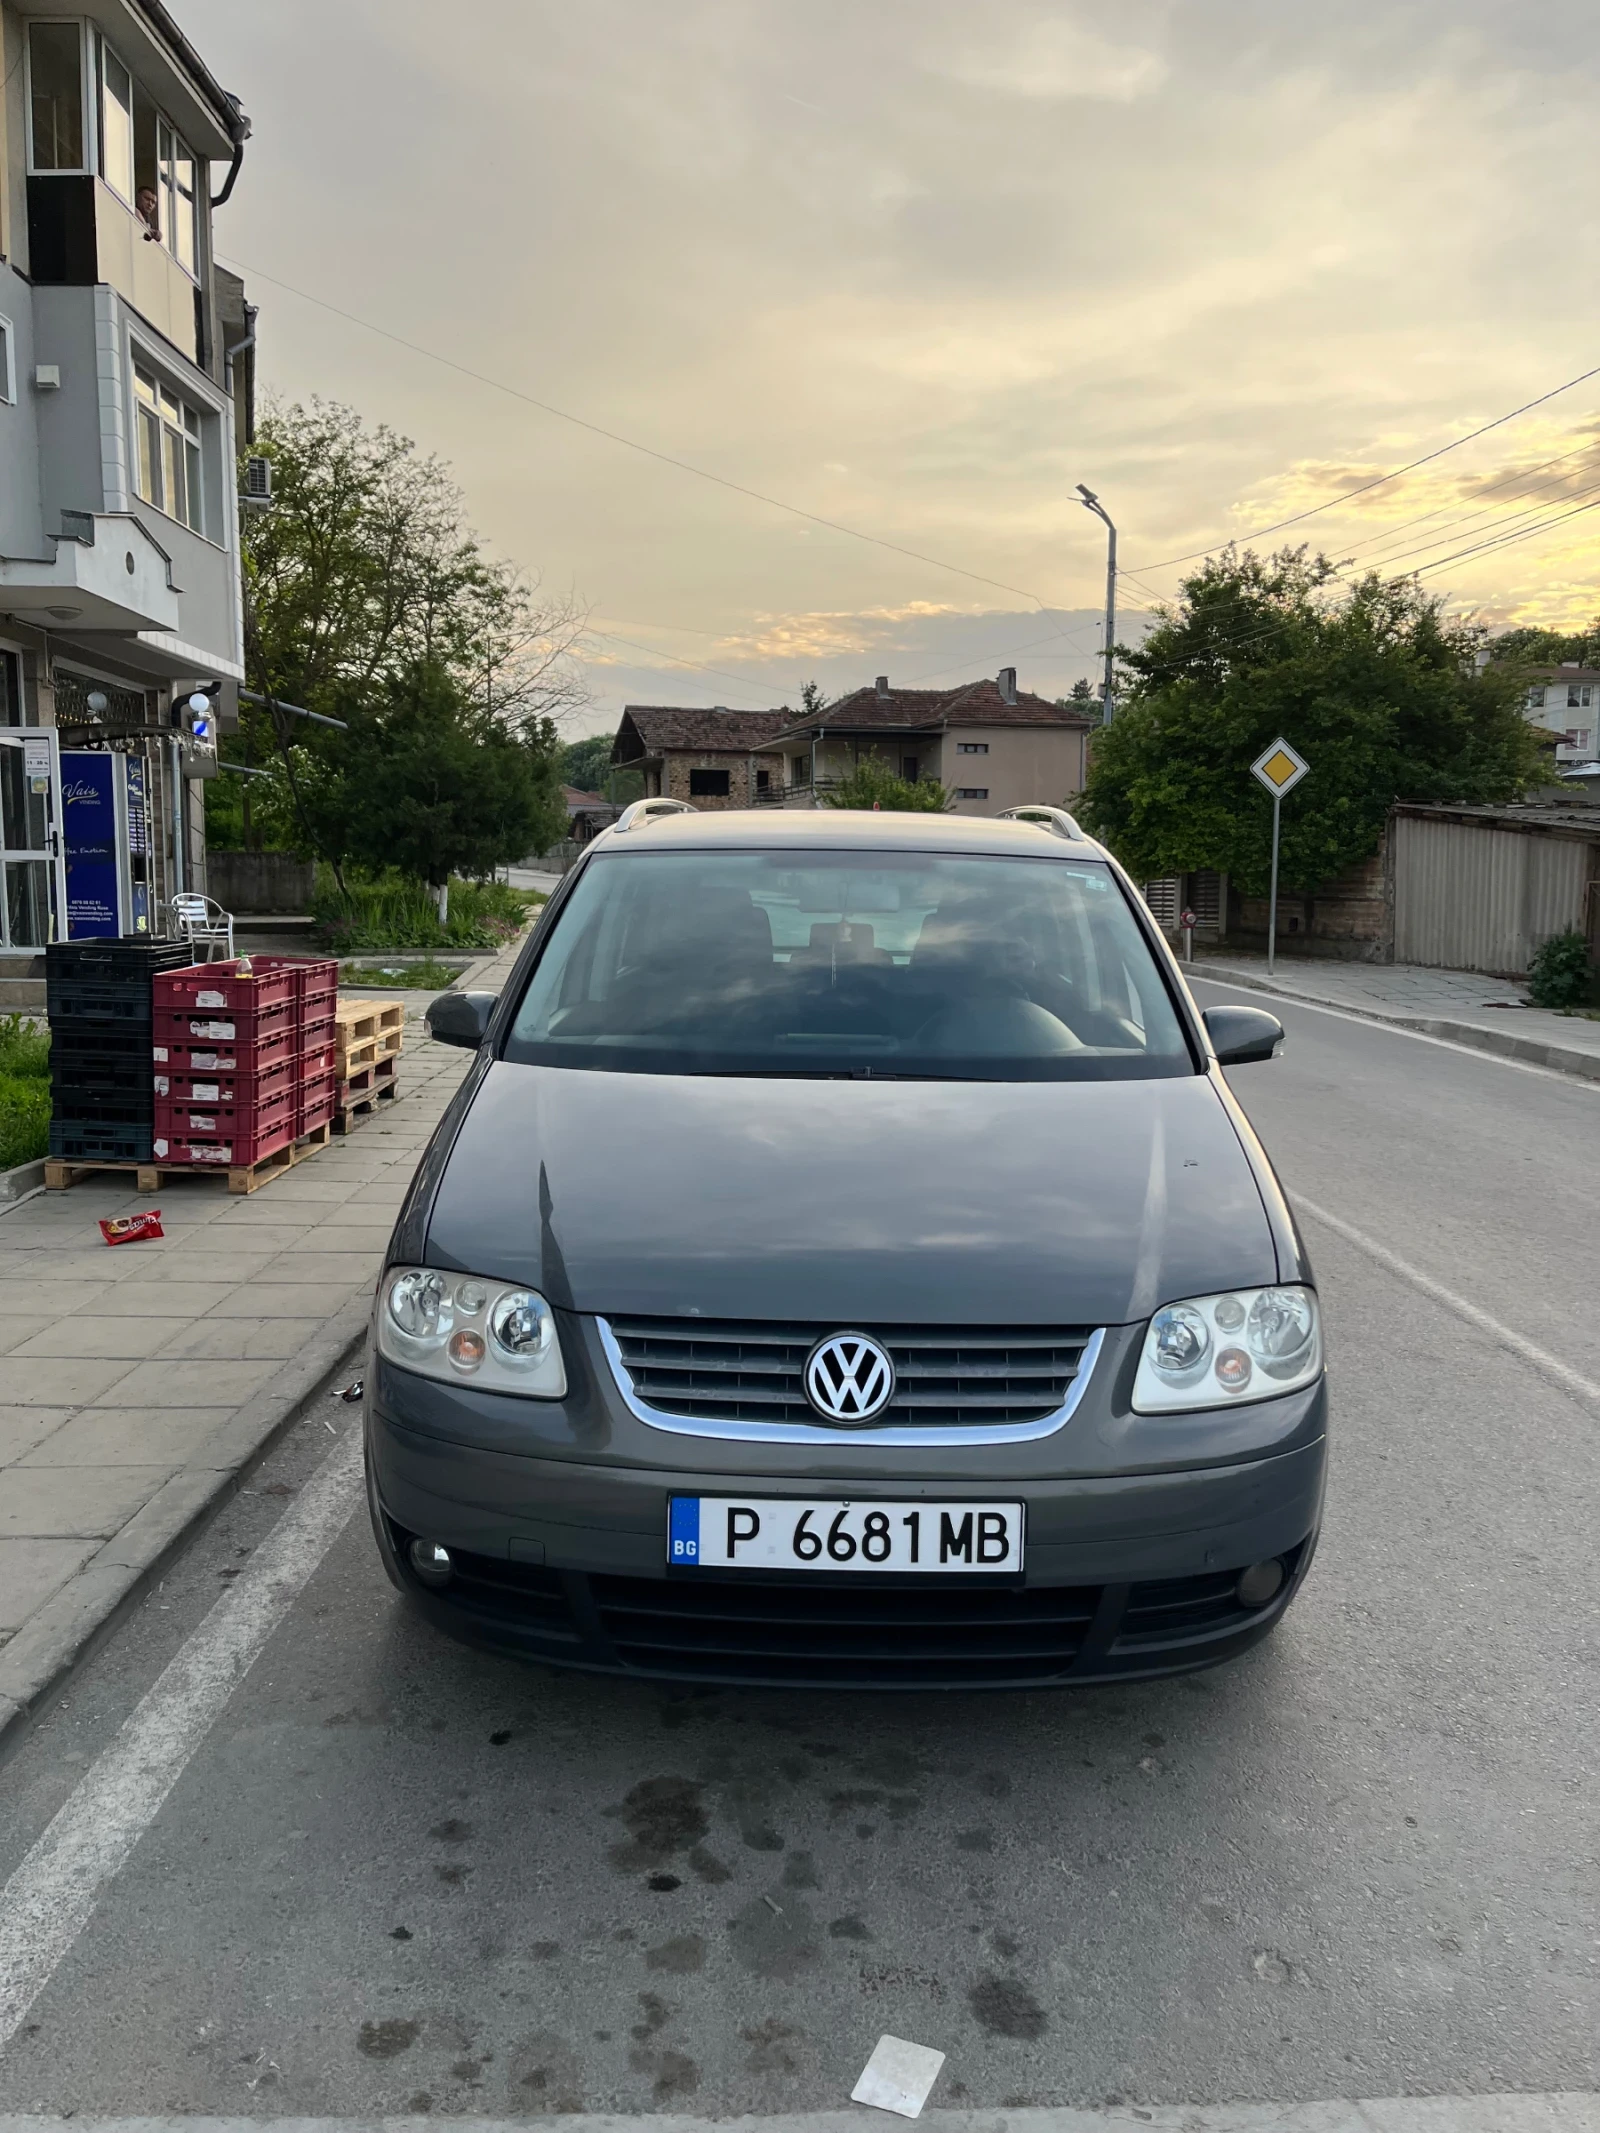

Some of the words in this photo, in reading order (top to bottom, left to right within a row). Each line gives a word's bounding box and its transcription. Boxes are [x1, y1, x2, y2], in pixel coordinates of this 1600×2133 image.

[62, 780, 97, 798] Vais
[726, 1506, 761, 1559] P
[792, 1508, 920, 1563] 6681
[939, 1510, 1010, 1564] MB
[673, 1539, 697, 1556] BG
